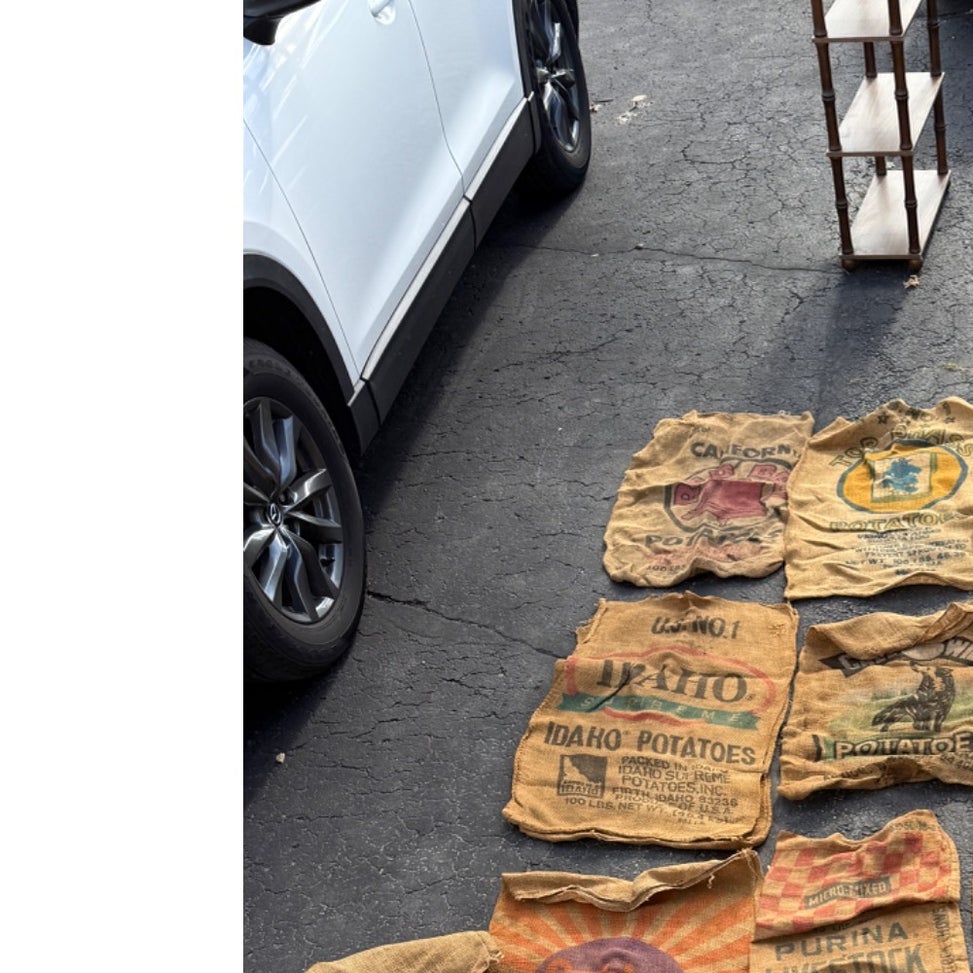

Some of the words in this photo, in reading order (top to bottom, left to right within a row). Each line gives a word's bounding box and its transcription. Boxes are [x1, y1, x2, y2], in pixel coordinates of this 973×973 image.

[690, 441, 799, 460] CAIFORN
[544, 721, 622, 751] IDAHO
[637, 730, 756, 766] POTATOES
[621, 755, 670, 770] PACKED
[807, 880, 887, 908] MICRO-MIXED
[775, 921, 909, 962] PURINA
